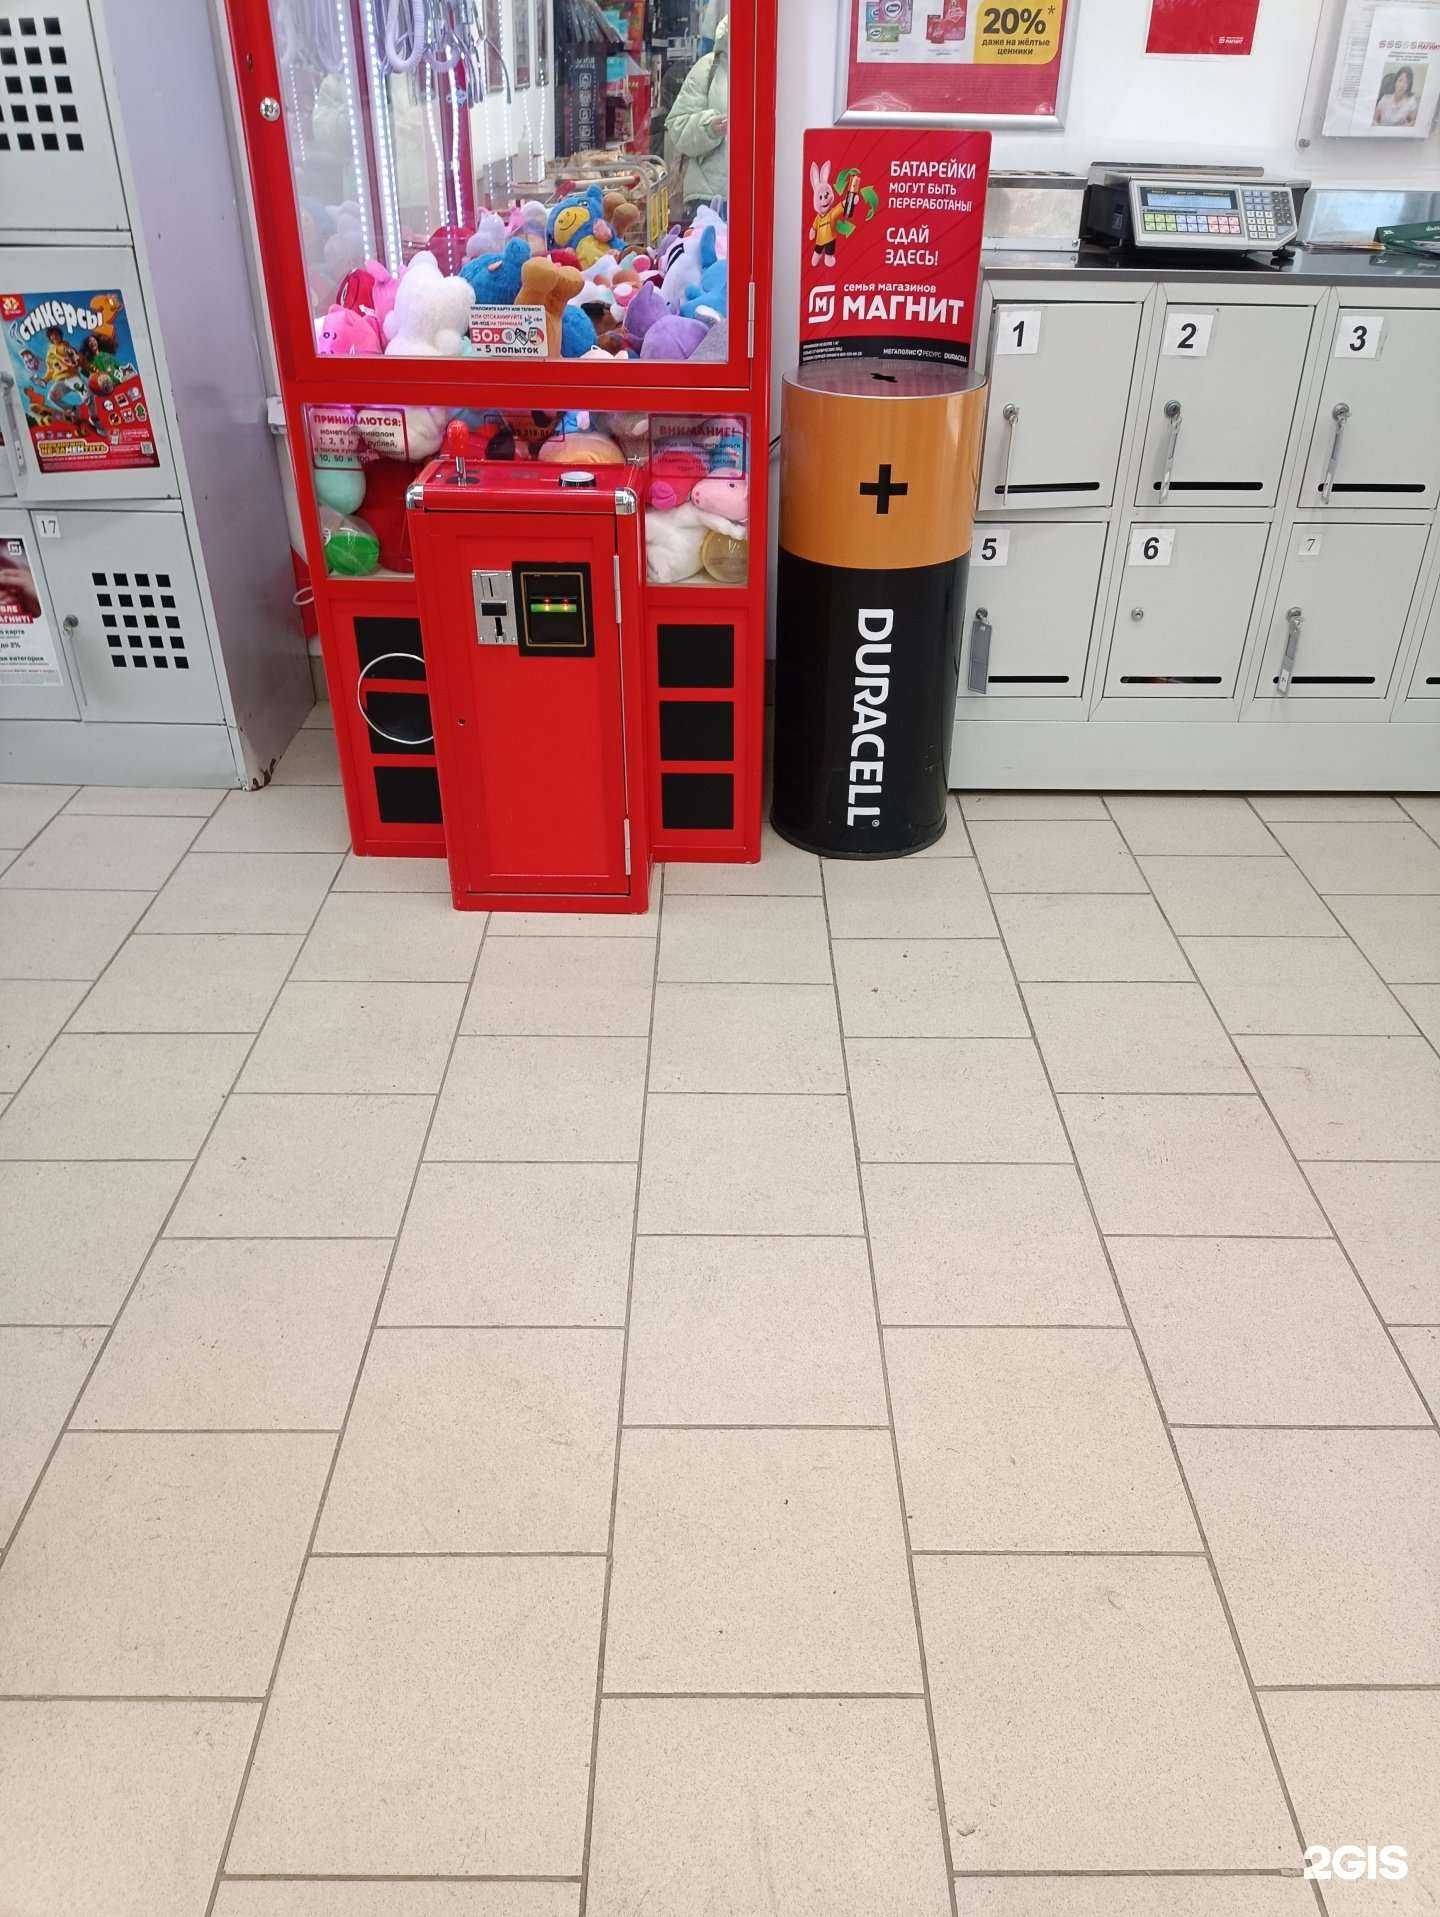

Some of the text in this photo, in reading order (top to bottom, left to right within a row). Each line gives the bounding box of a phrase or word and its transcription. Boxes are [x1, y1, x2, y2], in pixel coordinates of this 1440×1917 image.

[981, 38, 1050, 47] даже на жёлтые
[890, 159, 976, 180] БАТАРЕЙКИ
[889, 182, 957, 195] МОГУТ БЫТЬ
[888, 197, 972, 212] ПЕРЕРАБОТАНЫ!
[886, 225, 930, 246] СДАЙ
[885, 249, 939, 266] ЗДЕСЬ!
[843, 283, 937, 293] семья магазинов
[842, 295, 964, 325] МАГНИТ
[1012, 321, 1026, 347] 1
[1177, 323, 1197, 349] 2
[1349, 325, 1368, 351] 3
[485, 345, 492, 353] 5
[314, 414, 402, 427] ПРИНИМАЮТСЯ:
[41, 520, 57, 535] 17
[981, 537, 997, 561] 5
[1143, 537, 1160, 561] 6
[1304, 537, 1317, 553] 7
[847, 608, 894, 827] DURACELL
